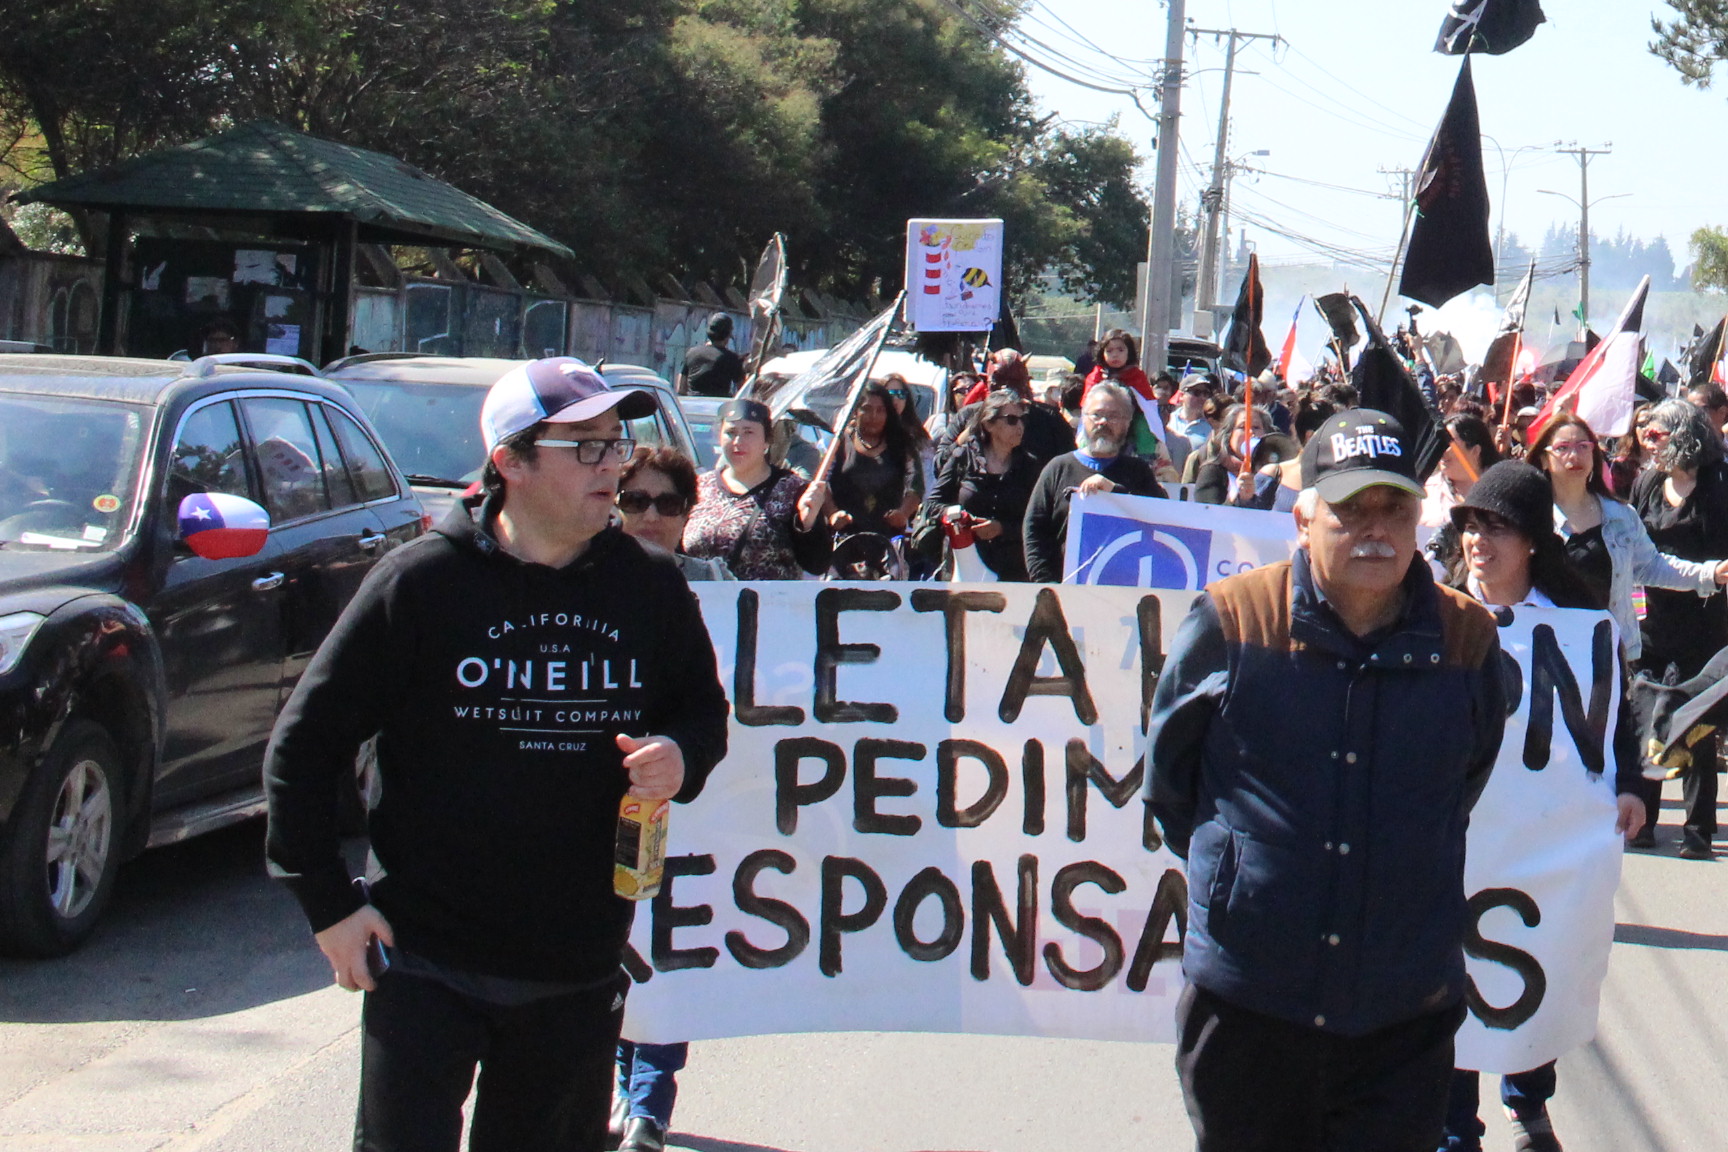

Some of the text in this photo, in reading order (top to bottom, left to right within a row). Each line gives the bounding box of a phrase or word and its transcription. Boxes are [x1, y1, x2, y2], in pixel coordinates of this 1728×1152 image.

[1355, 425, 1375, 435] THE
[1331, 432, 1402, 464] BEATLES
[1217, 559, 1266, 578] CO
[488, 612, 621, 642] CAIFORNIA
[456, 655, 643, 691] O'NEILL
[453, 706, 642, 723] WETSUIT COMPANY
[519, 740, 587, 752] SANTA CRUZ
